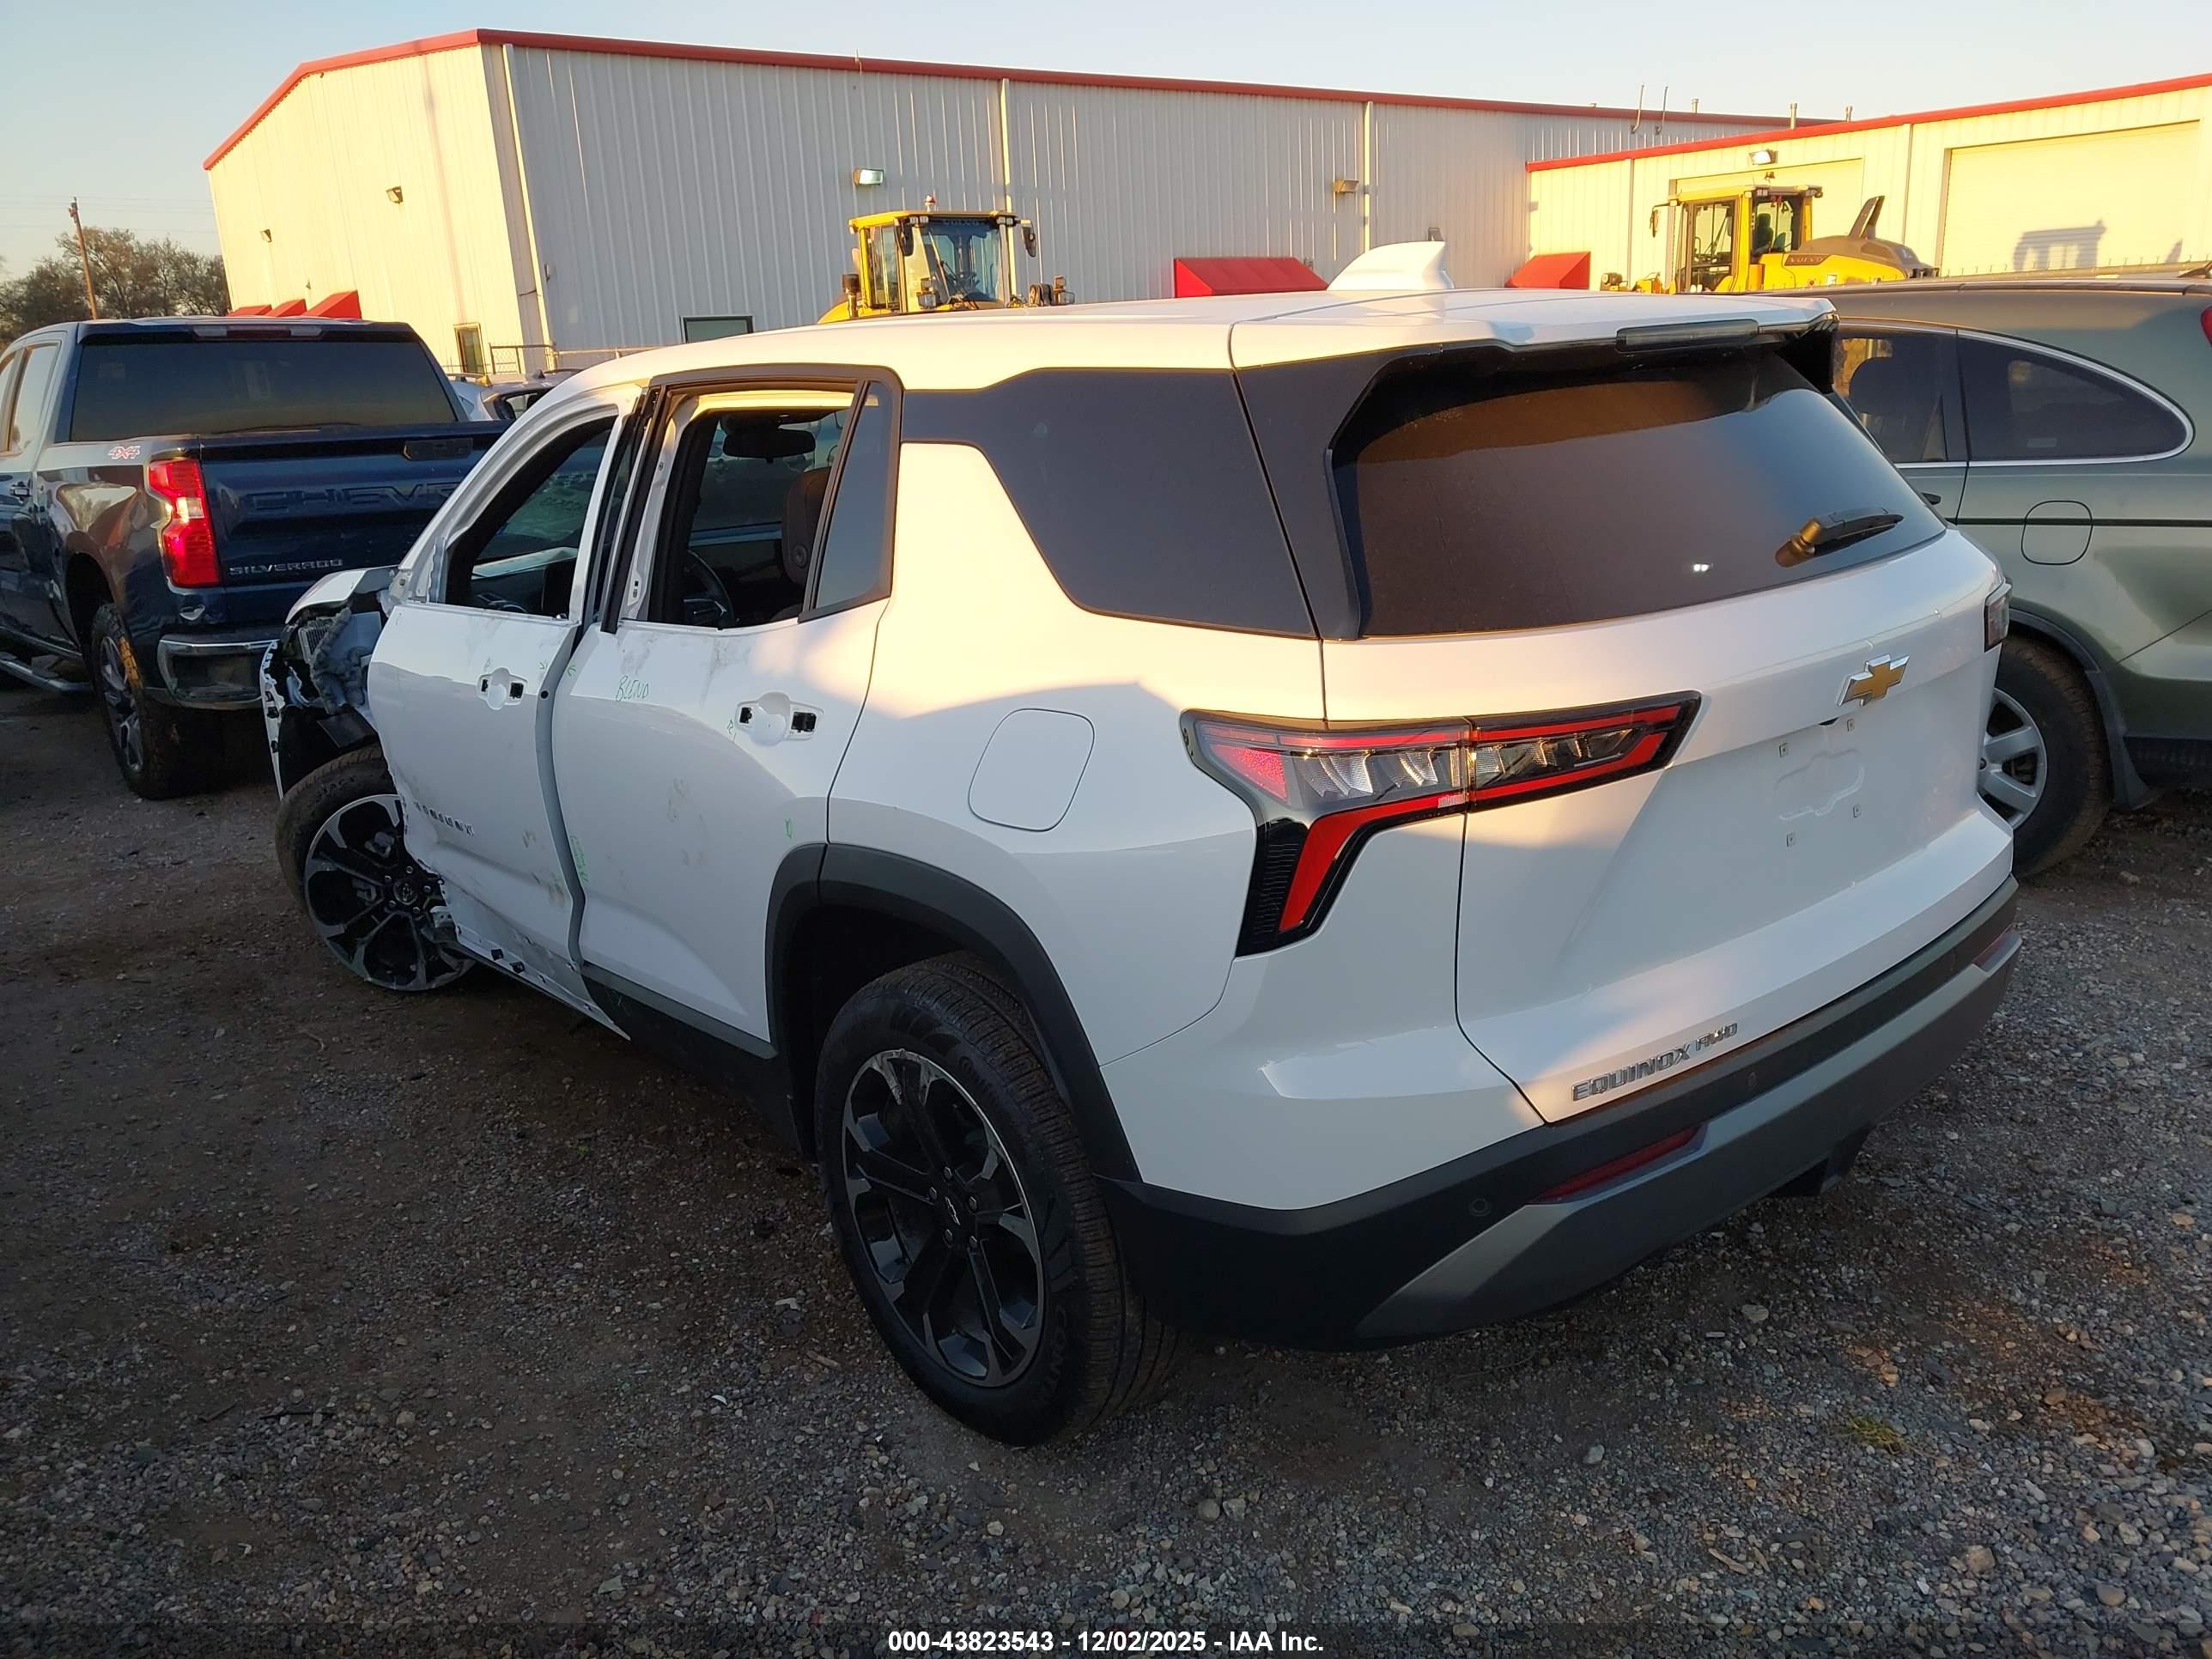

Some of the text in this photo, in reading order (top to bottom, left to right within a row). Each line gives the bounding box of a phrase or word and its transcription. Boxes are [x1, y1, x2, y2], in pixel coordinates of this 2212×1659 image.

[228, 558, 343, 576] SILVERADO
[1571, 1022, 1738, 1102] EQUINOX AWD
